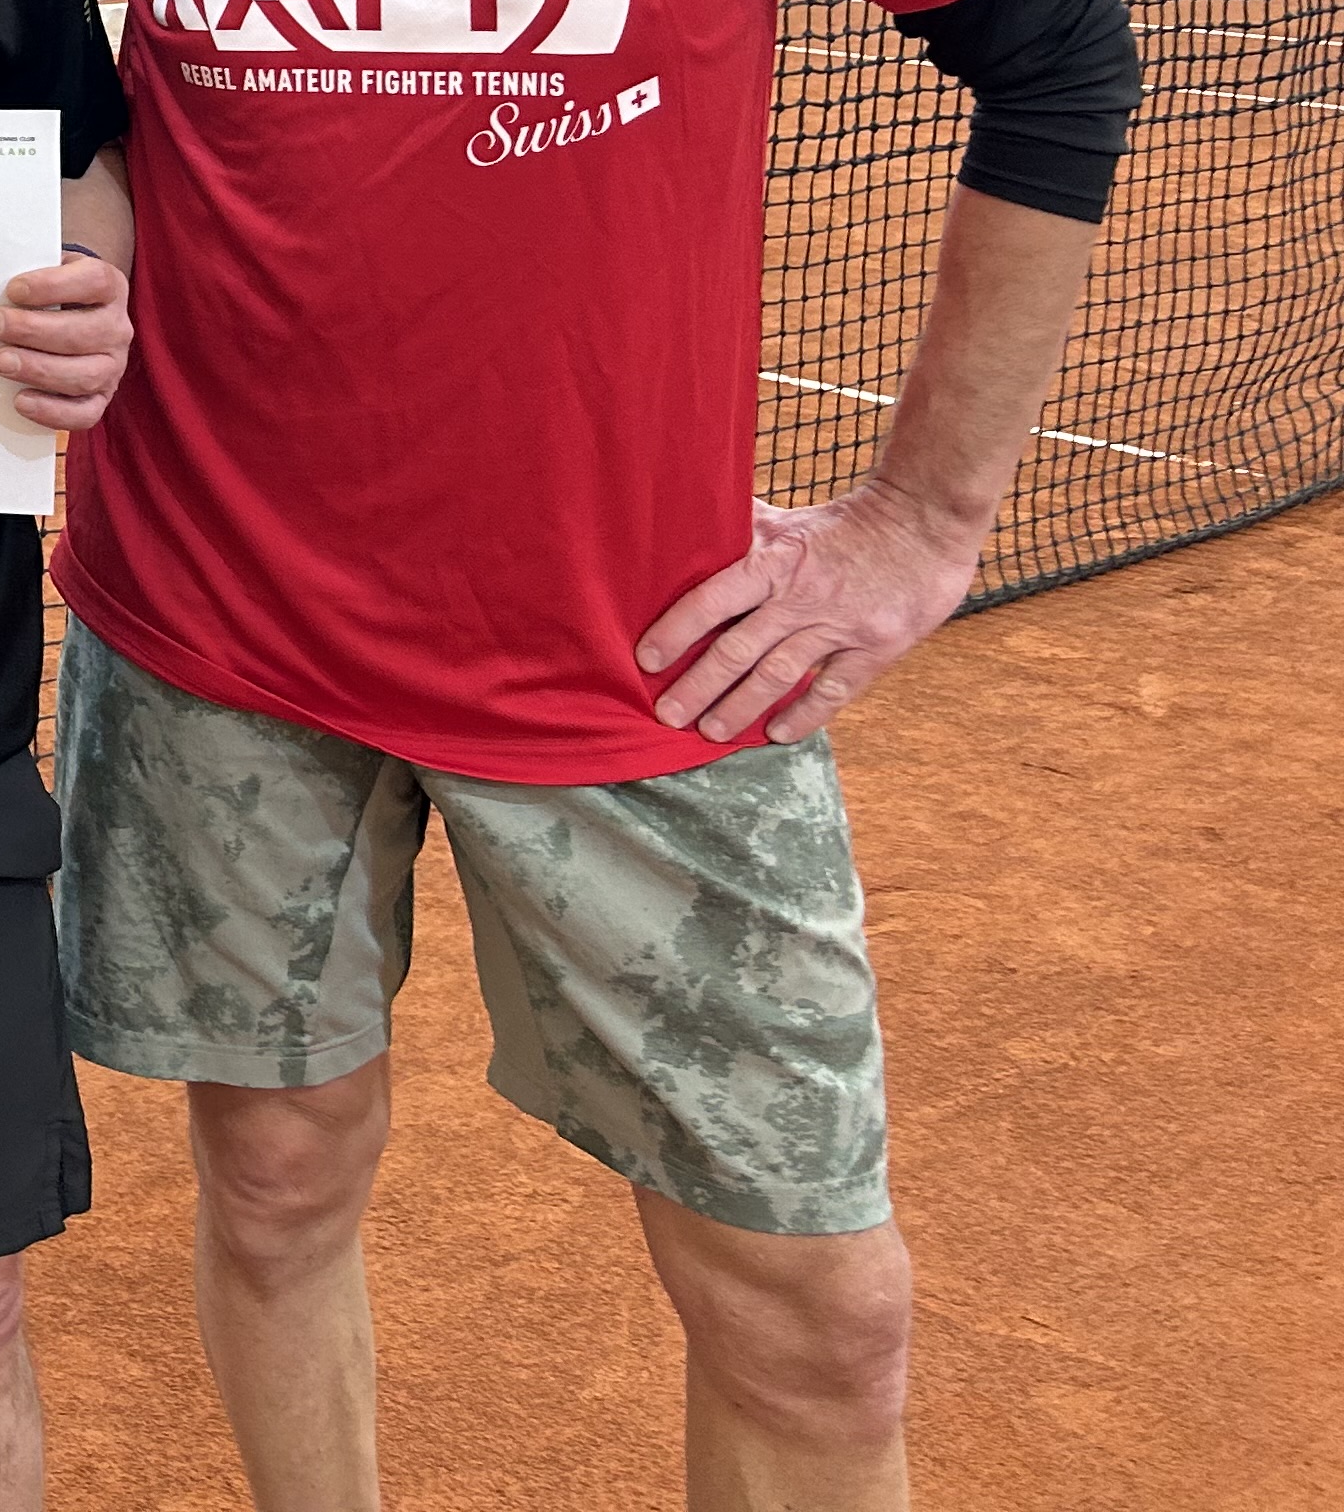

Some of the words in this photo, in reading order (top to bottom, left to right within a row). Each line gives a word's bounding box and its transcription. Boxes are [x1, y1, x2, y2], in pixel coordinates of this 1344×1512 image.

[180, 61, 237, 91] REBEL
[243, 69, 352, 94] AMATEUR
[361, 70, 464, 96] FIGHTER
[472, 71, 565, 97] TENNIS
[466, 99, 612, 167] Swiss
